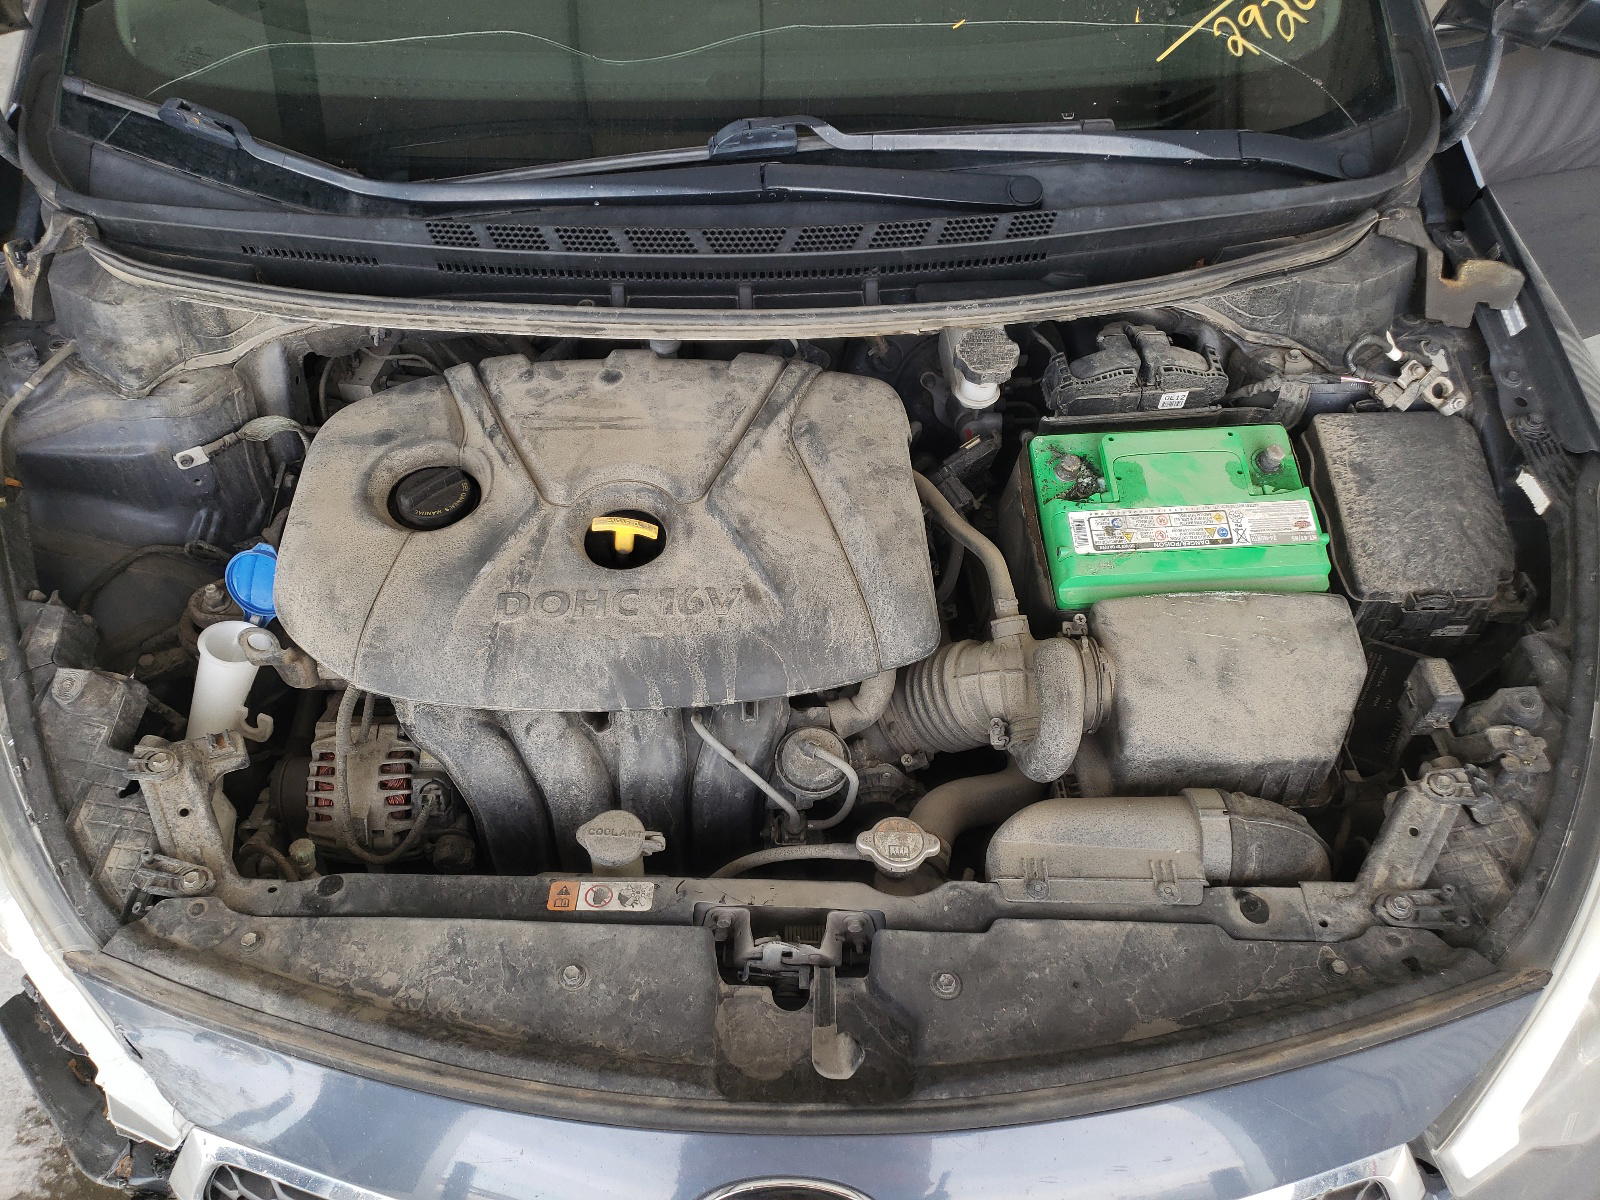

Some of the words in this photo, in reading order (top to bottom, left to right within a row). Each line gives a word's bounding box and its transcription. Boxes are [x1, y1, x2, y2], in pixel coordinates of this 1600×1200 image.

[496, 588, 641, 617] DOHC
[659, 586, 742, 616] 16V
[588, 828, 643, 838] COOLANT
